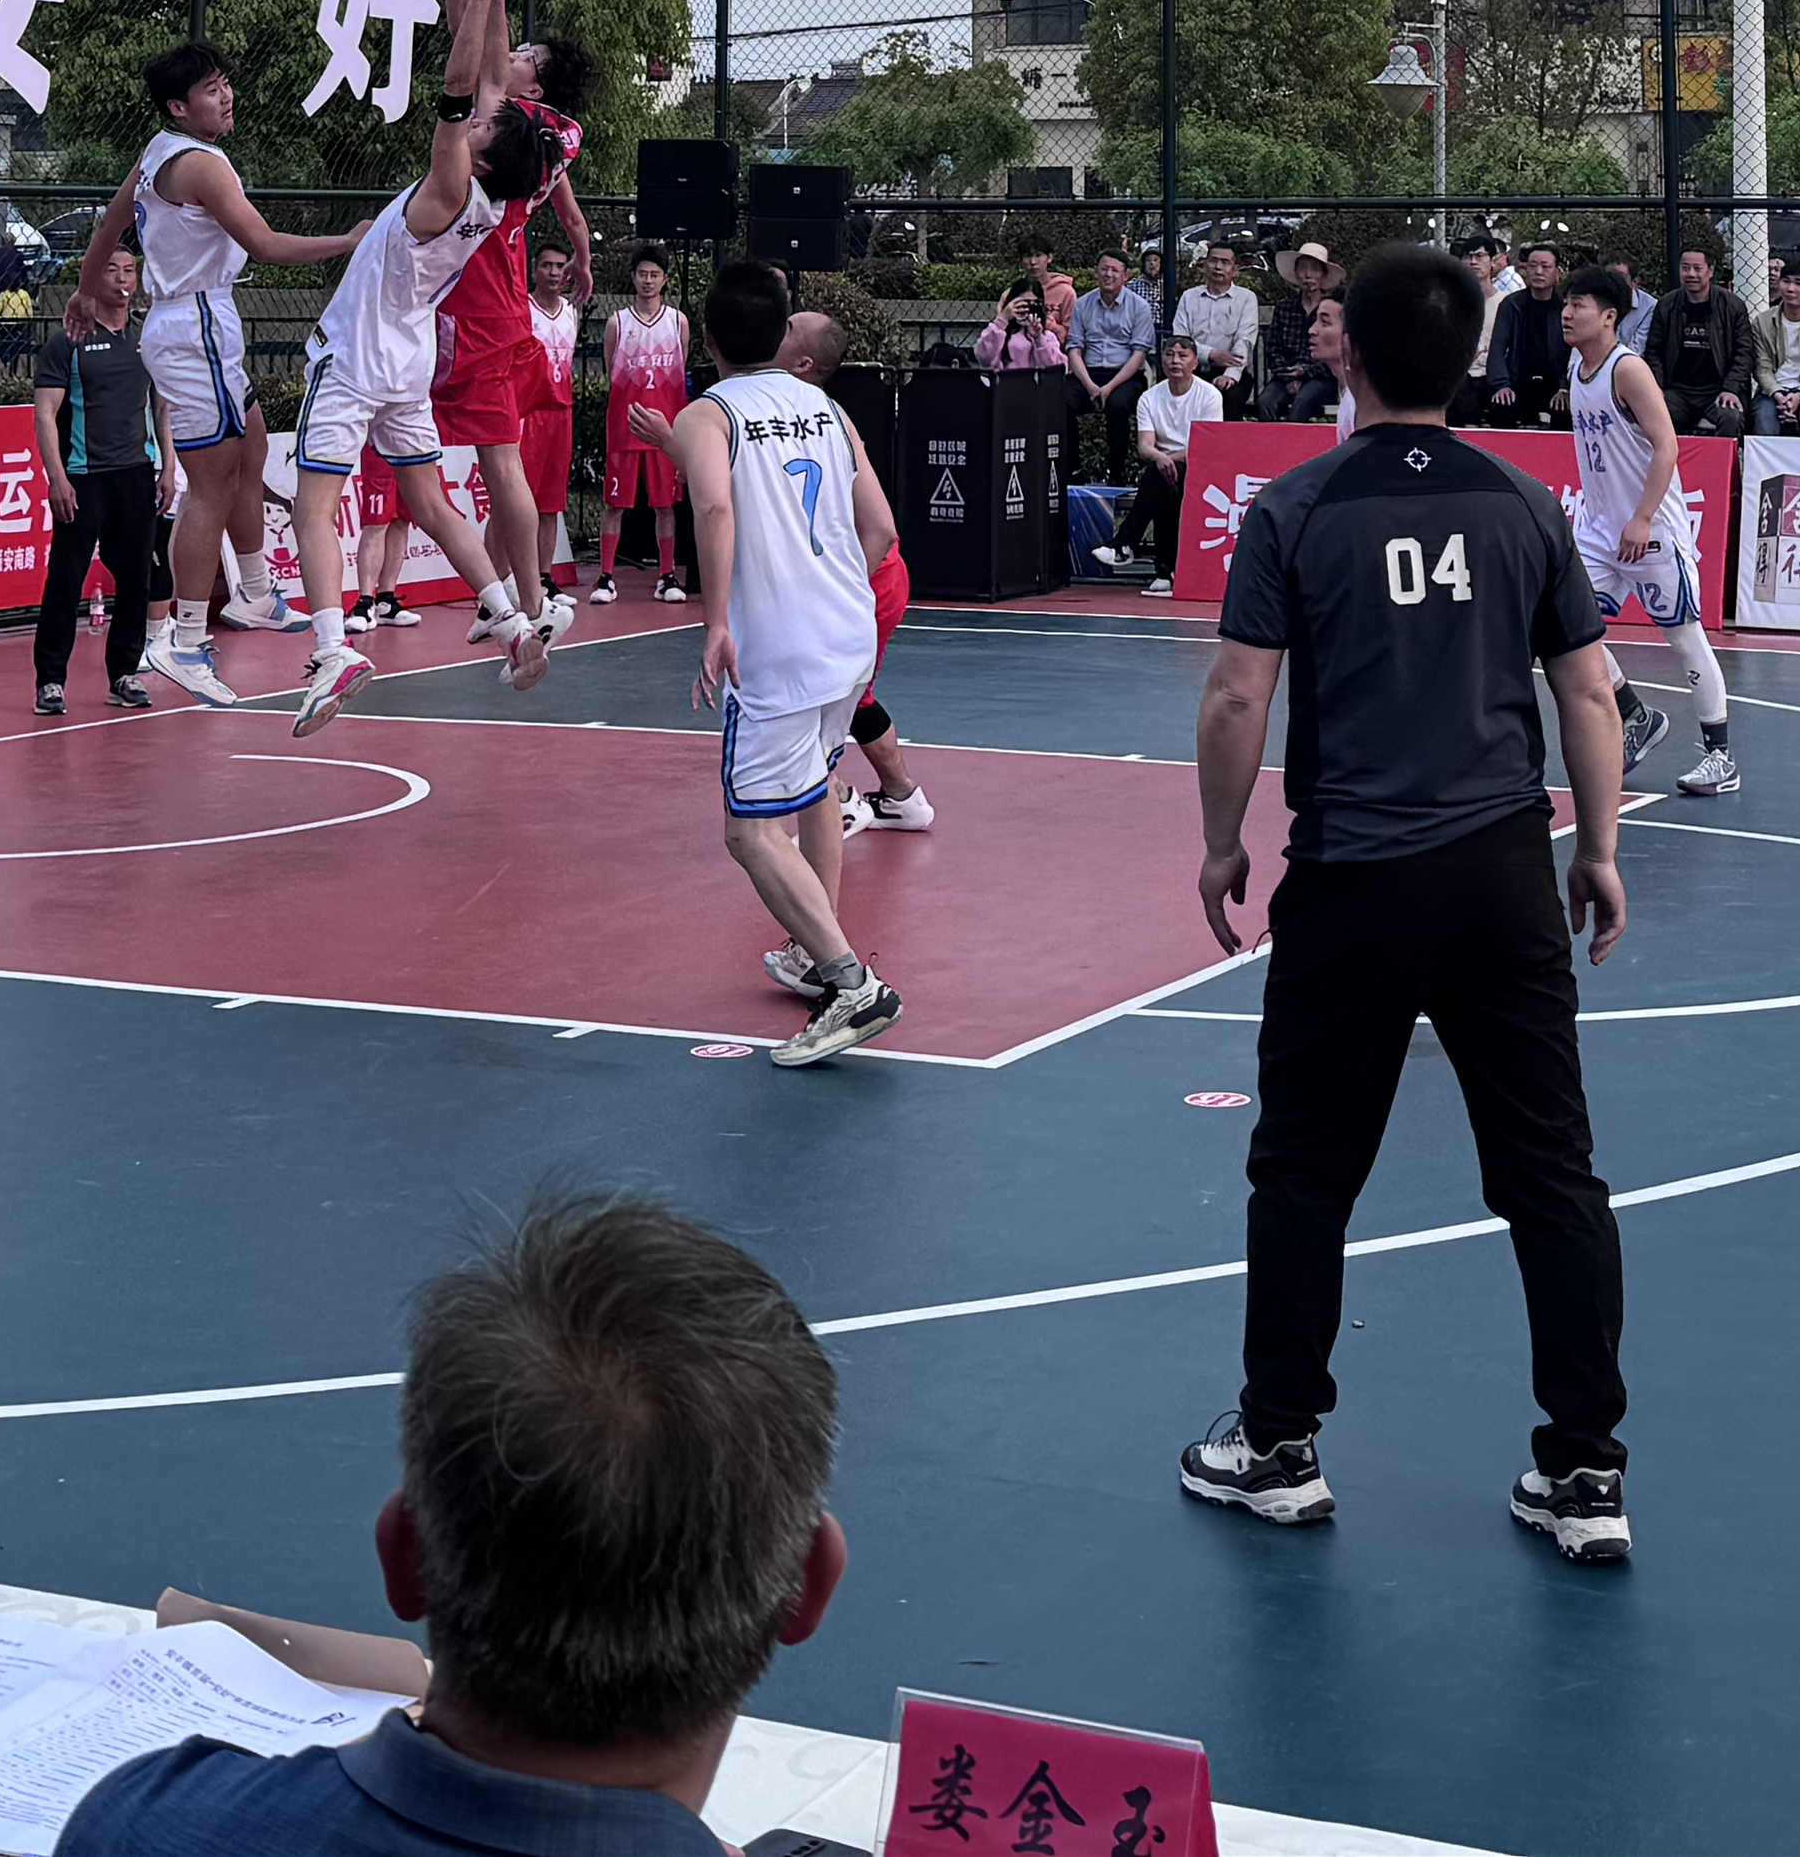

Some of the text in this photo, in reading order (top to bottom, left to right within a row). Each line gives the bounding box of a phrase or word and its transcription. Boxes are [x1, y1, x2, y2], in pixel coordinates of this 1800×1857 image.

[645, 370, 655, 390] 2
[744, 412, 833, 444] 年丰水产
[1585, 441, 1606, 472] 12
[368, 494, 384, 516] 11
[783, 458, 822, 556] 7
[1386, 533, 1472, 605] 04
[1636, 582, 1667, 612] 12
